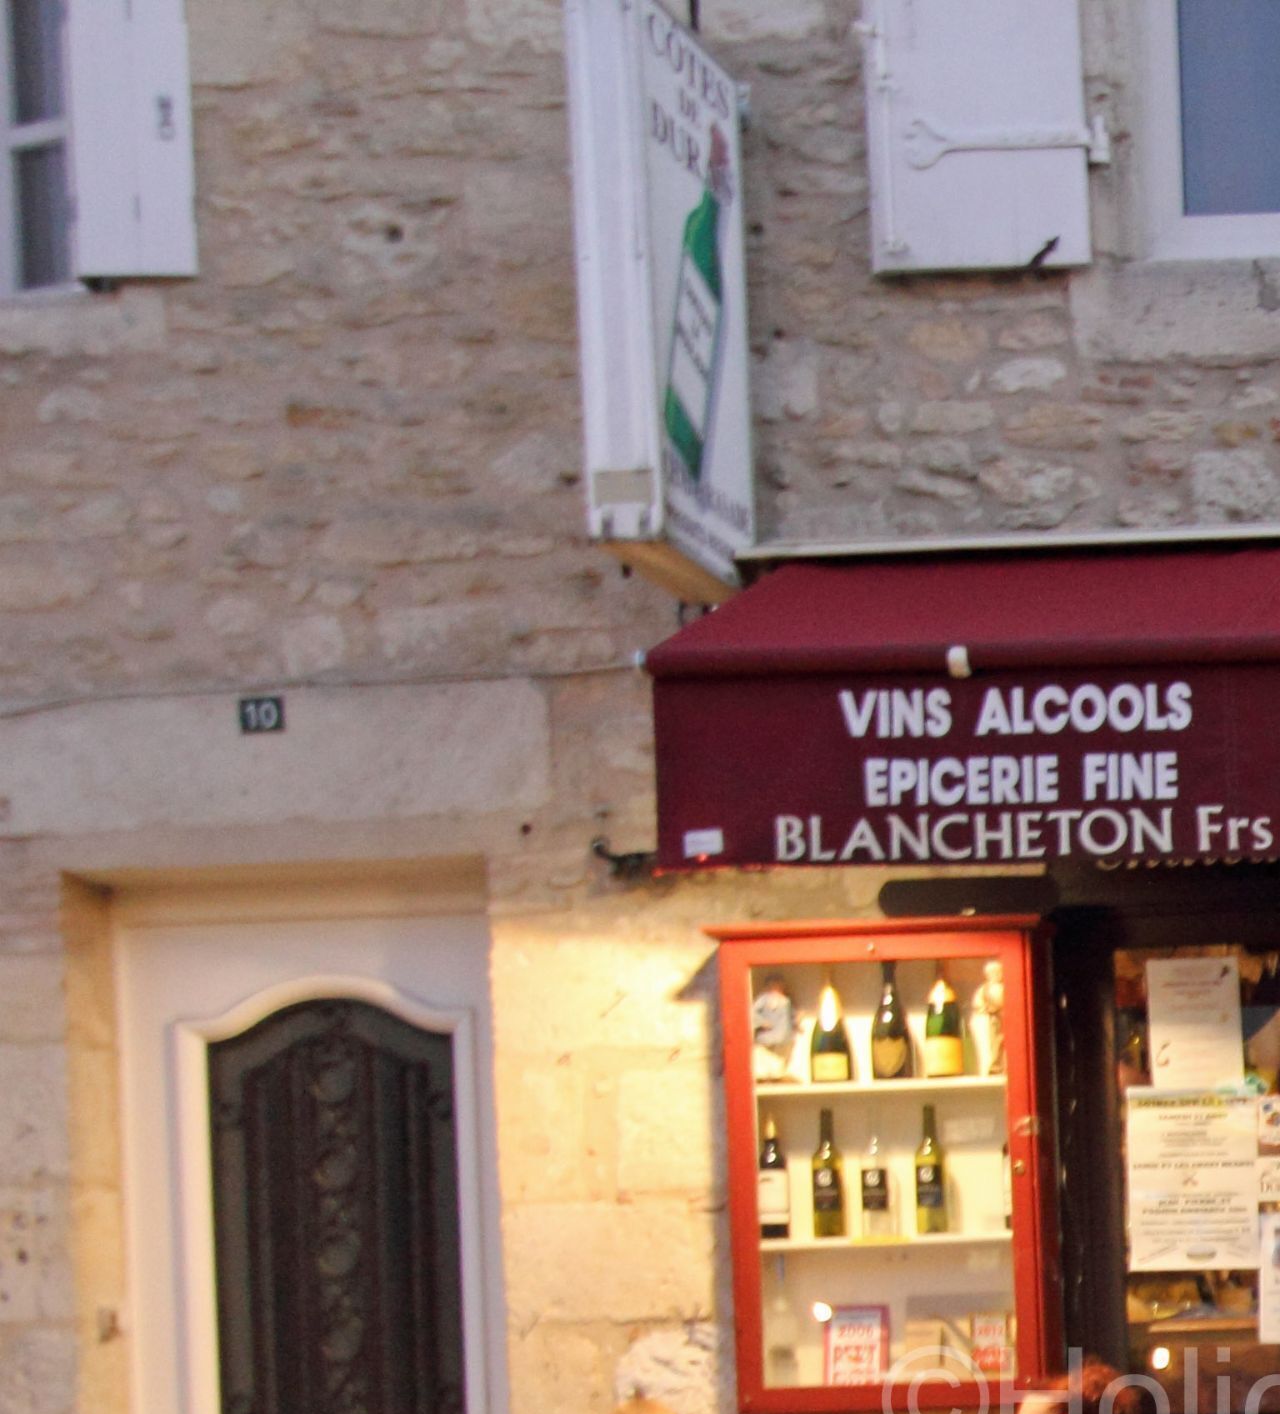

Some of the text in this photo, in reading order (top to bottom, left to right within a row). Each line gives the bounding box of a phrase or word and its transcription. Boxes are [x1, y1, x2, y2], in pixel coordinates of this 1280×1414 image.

[246, 700, 278, 729] 10
[840, 682, 1193, 738] VINS ALCOOLS
[865, 751, 1178, 807] EPICERIE FINE
[775, 807, 1173, 863] BLANCHETON
[1198, 805, 1273, 850] Frs
